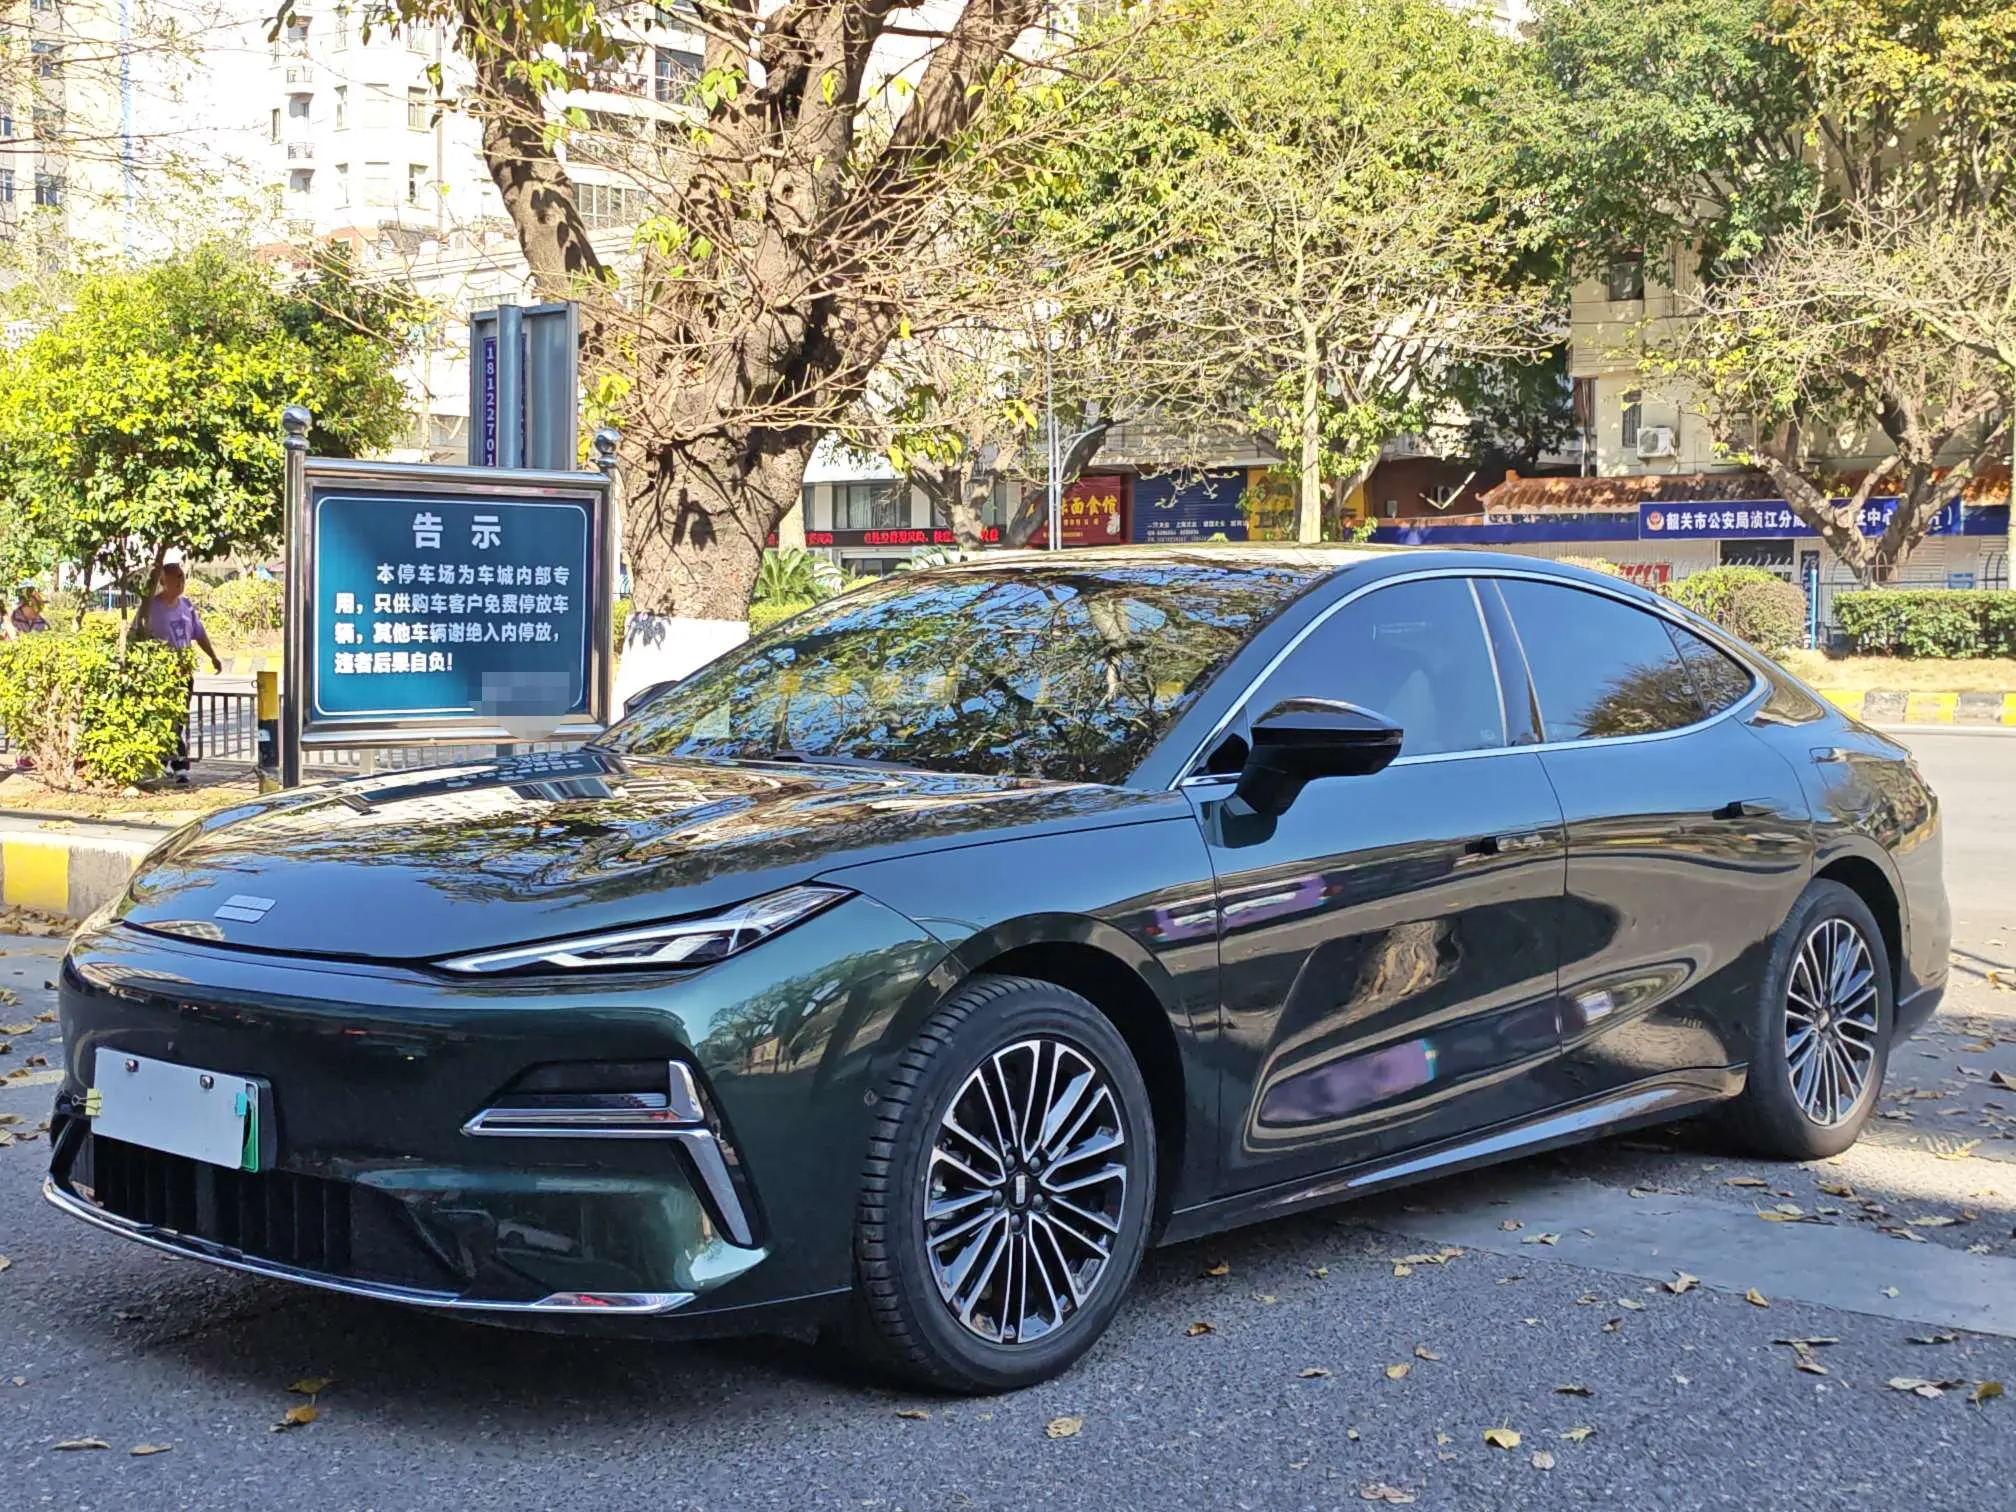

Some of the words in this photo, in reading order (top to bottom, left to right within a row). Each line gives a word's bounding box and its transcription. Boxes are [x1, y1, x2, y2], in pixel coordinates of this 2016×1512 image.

[486, 346, 495, 467] 18122701
[412, 511, 501, 549] 告示
[376, 562, 570, 586] 本停车场为车城内部专
[335, 592, 569, 614] 用，只供购车客户免费停放车
[334, 621, 561, 644] 辆，其他车辆谢绝入内停放，
[334, 651, 453, 674] 违者后果自负！
